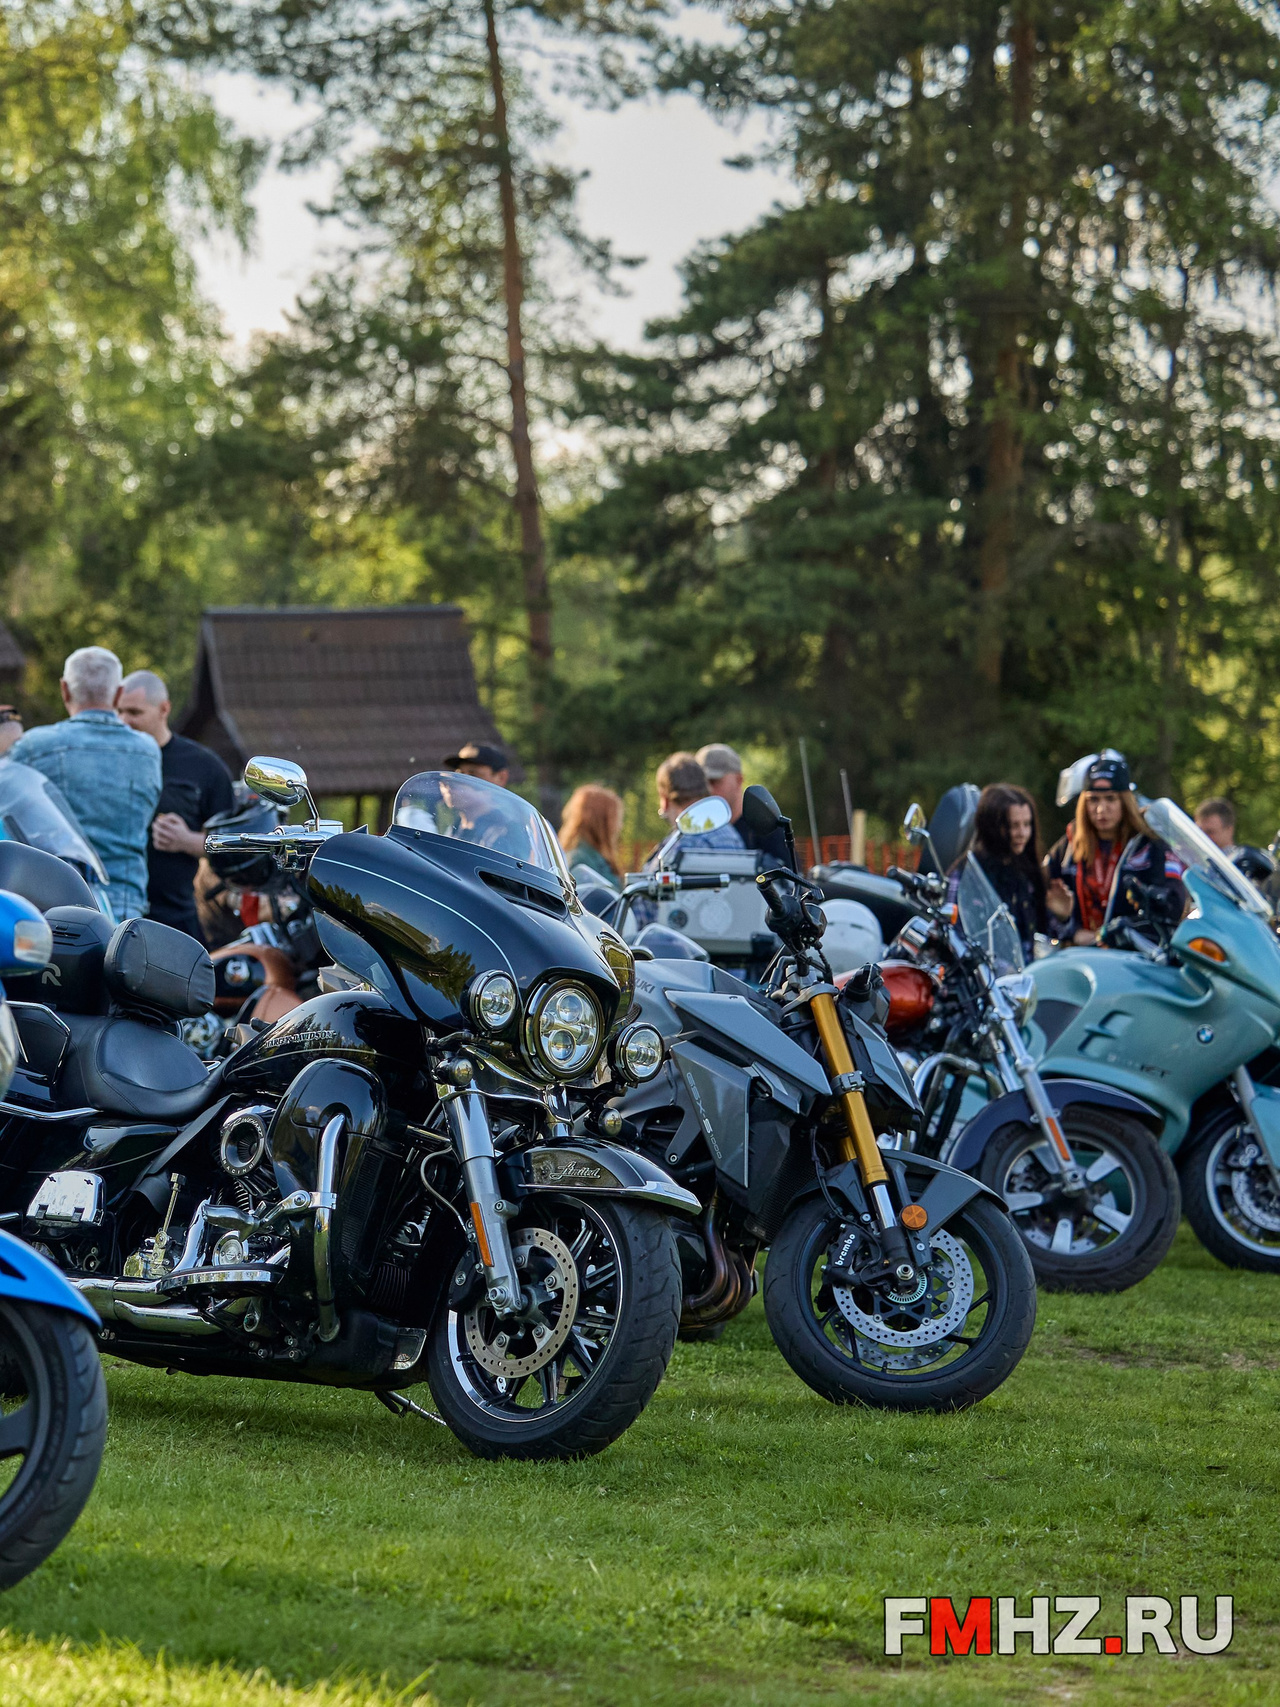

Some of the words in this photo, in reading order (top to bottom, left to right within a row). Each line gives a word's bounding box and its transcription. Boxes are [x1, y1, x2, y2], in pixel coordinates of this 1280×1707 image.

[222, 1157, 256, 1175] RACING
[550, 1160, 601, 1180] Limited
[834, 1233, 856, 1266] brembo
